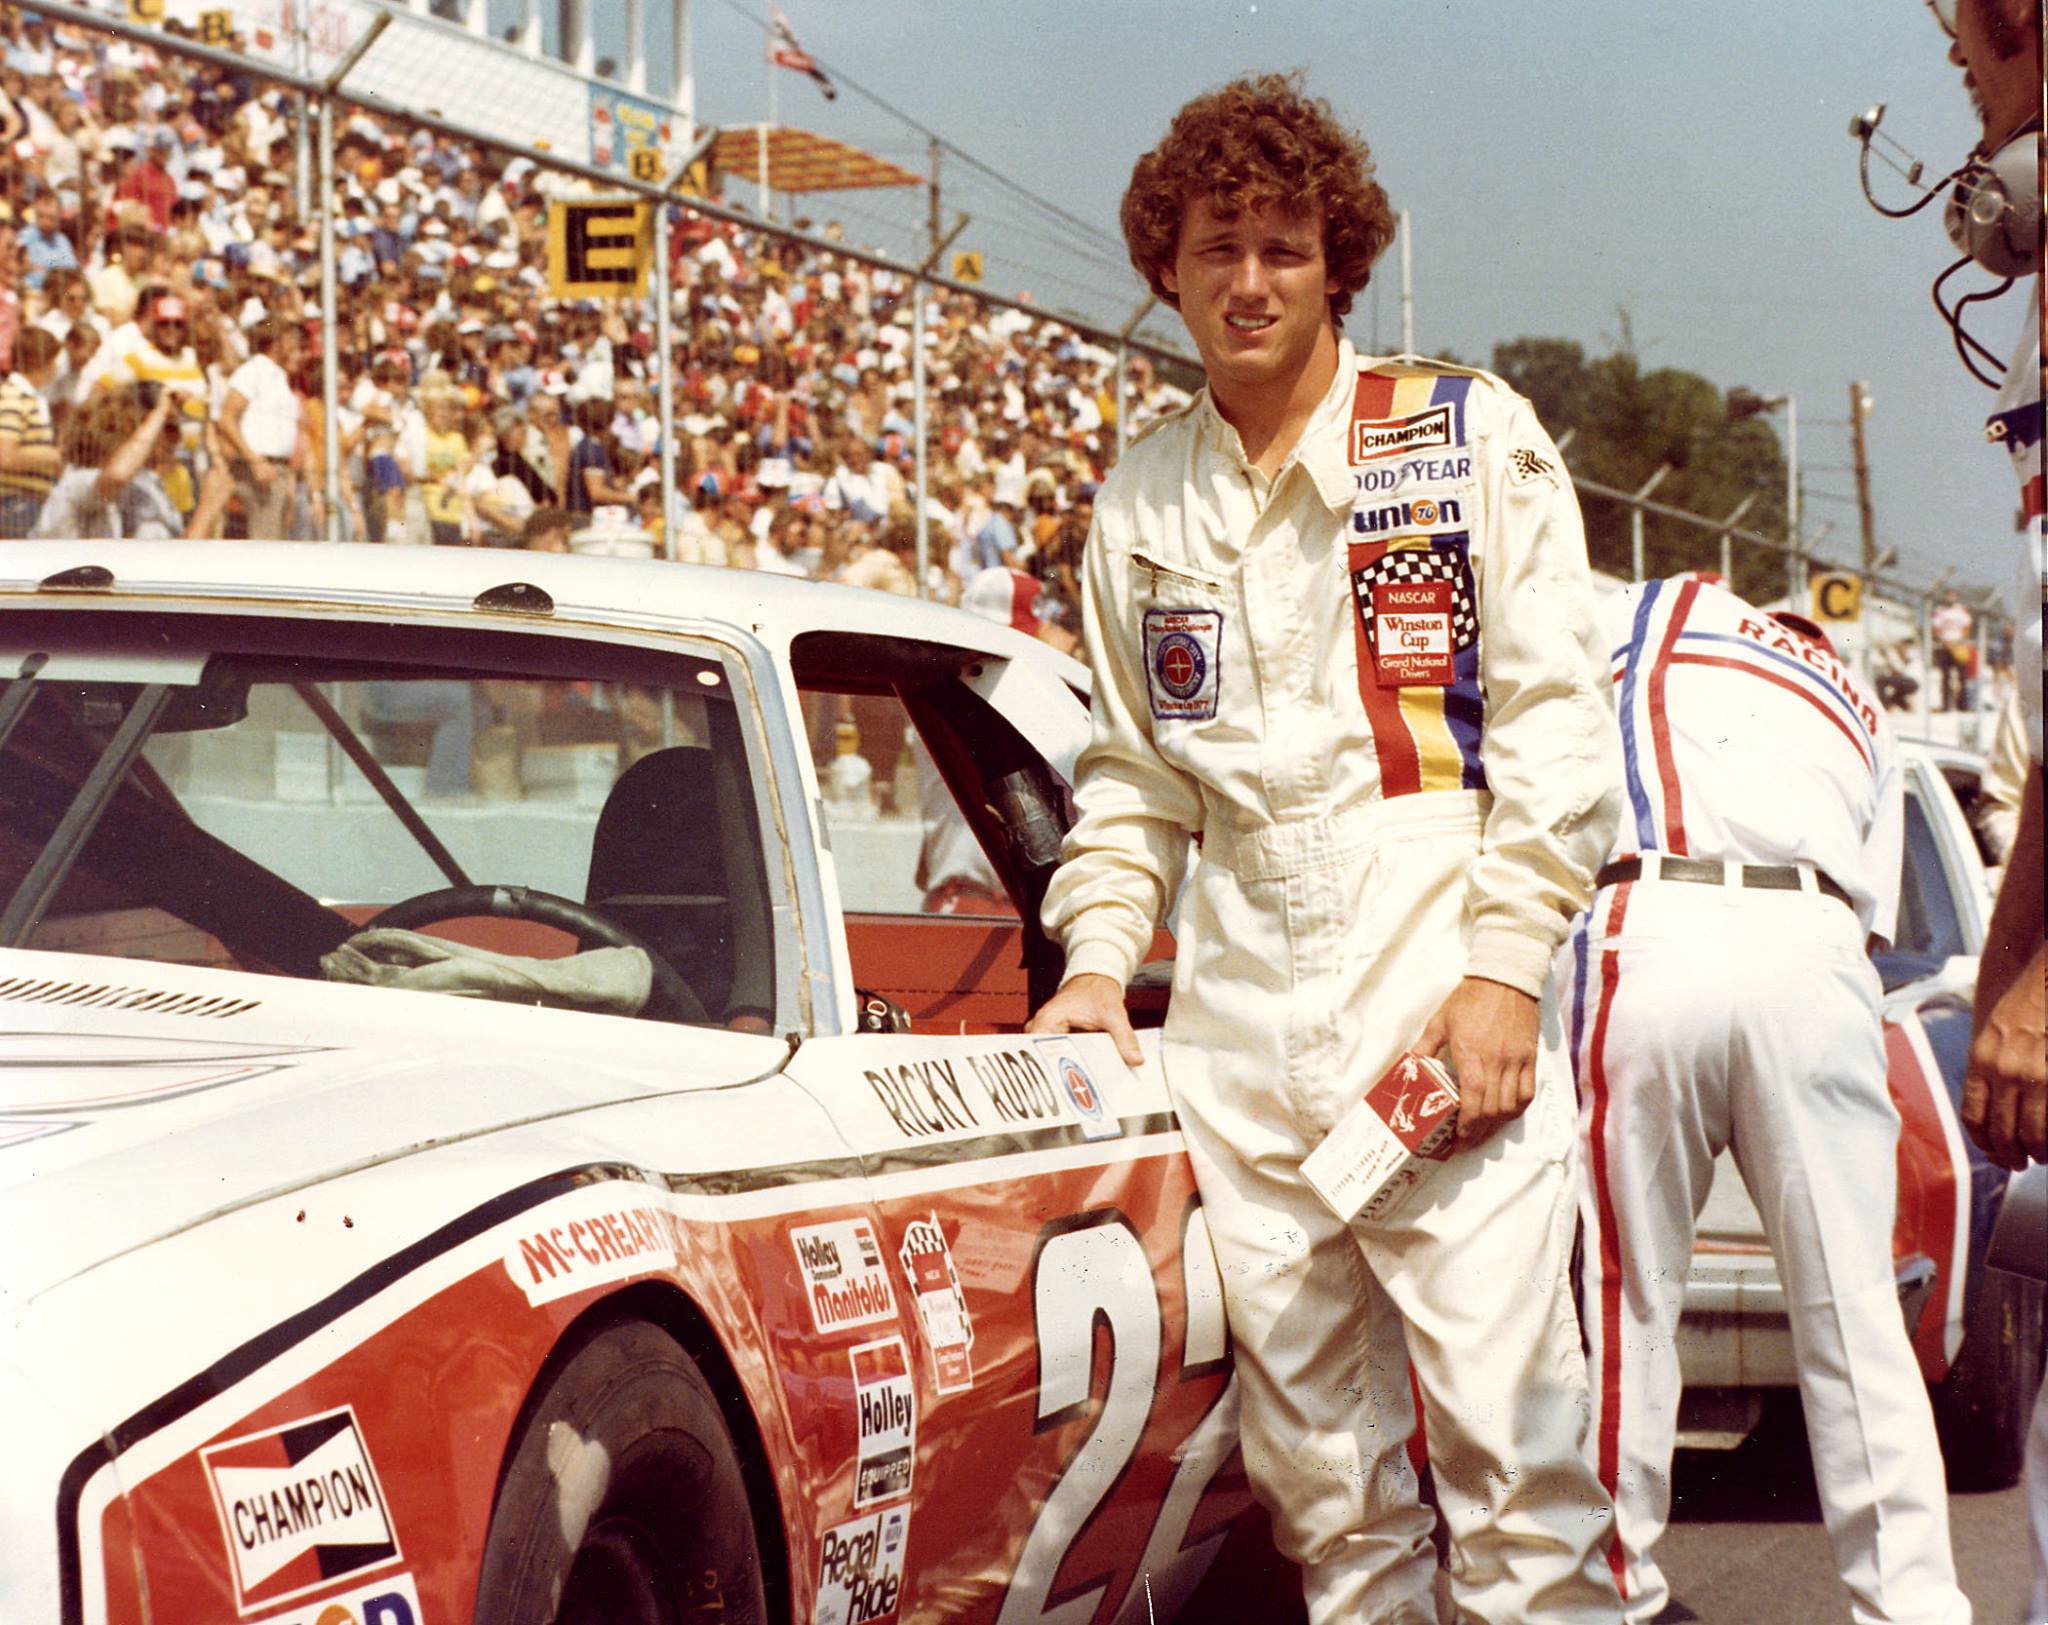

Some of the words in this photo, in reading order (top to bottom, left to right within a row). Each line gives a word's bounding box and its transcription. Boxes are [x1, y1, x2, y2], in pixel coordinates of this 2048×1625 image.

[566, 207, 636, 282] E
[1364, 421, 1444, 448] CHAMPION
[1388, 592, 1436, 604] NASCAR
[1820, 579, 1852, 618] C
[1384, 617, 1443, 631] Winston
[1401, 632, 1430, 651] Cup
[1381, 656, 1409, 669] Grand
[1411, 655, 1448, 668] National
[863, 1059, 979, 1137] RICKY
[966, 1049, 1060, 1122] RUDD
[797, 1235, 842, 1275] Holley
[860, 1386, 911, 1437] Holley
[861, 1459, 910, 1487] EQUIPPED
[234, 1464, 372, 1550] CHAMPION
[819, 1513, 882, 1590] Regal
[846, 1563, 898, 1625] Ride
